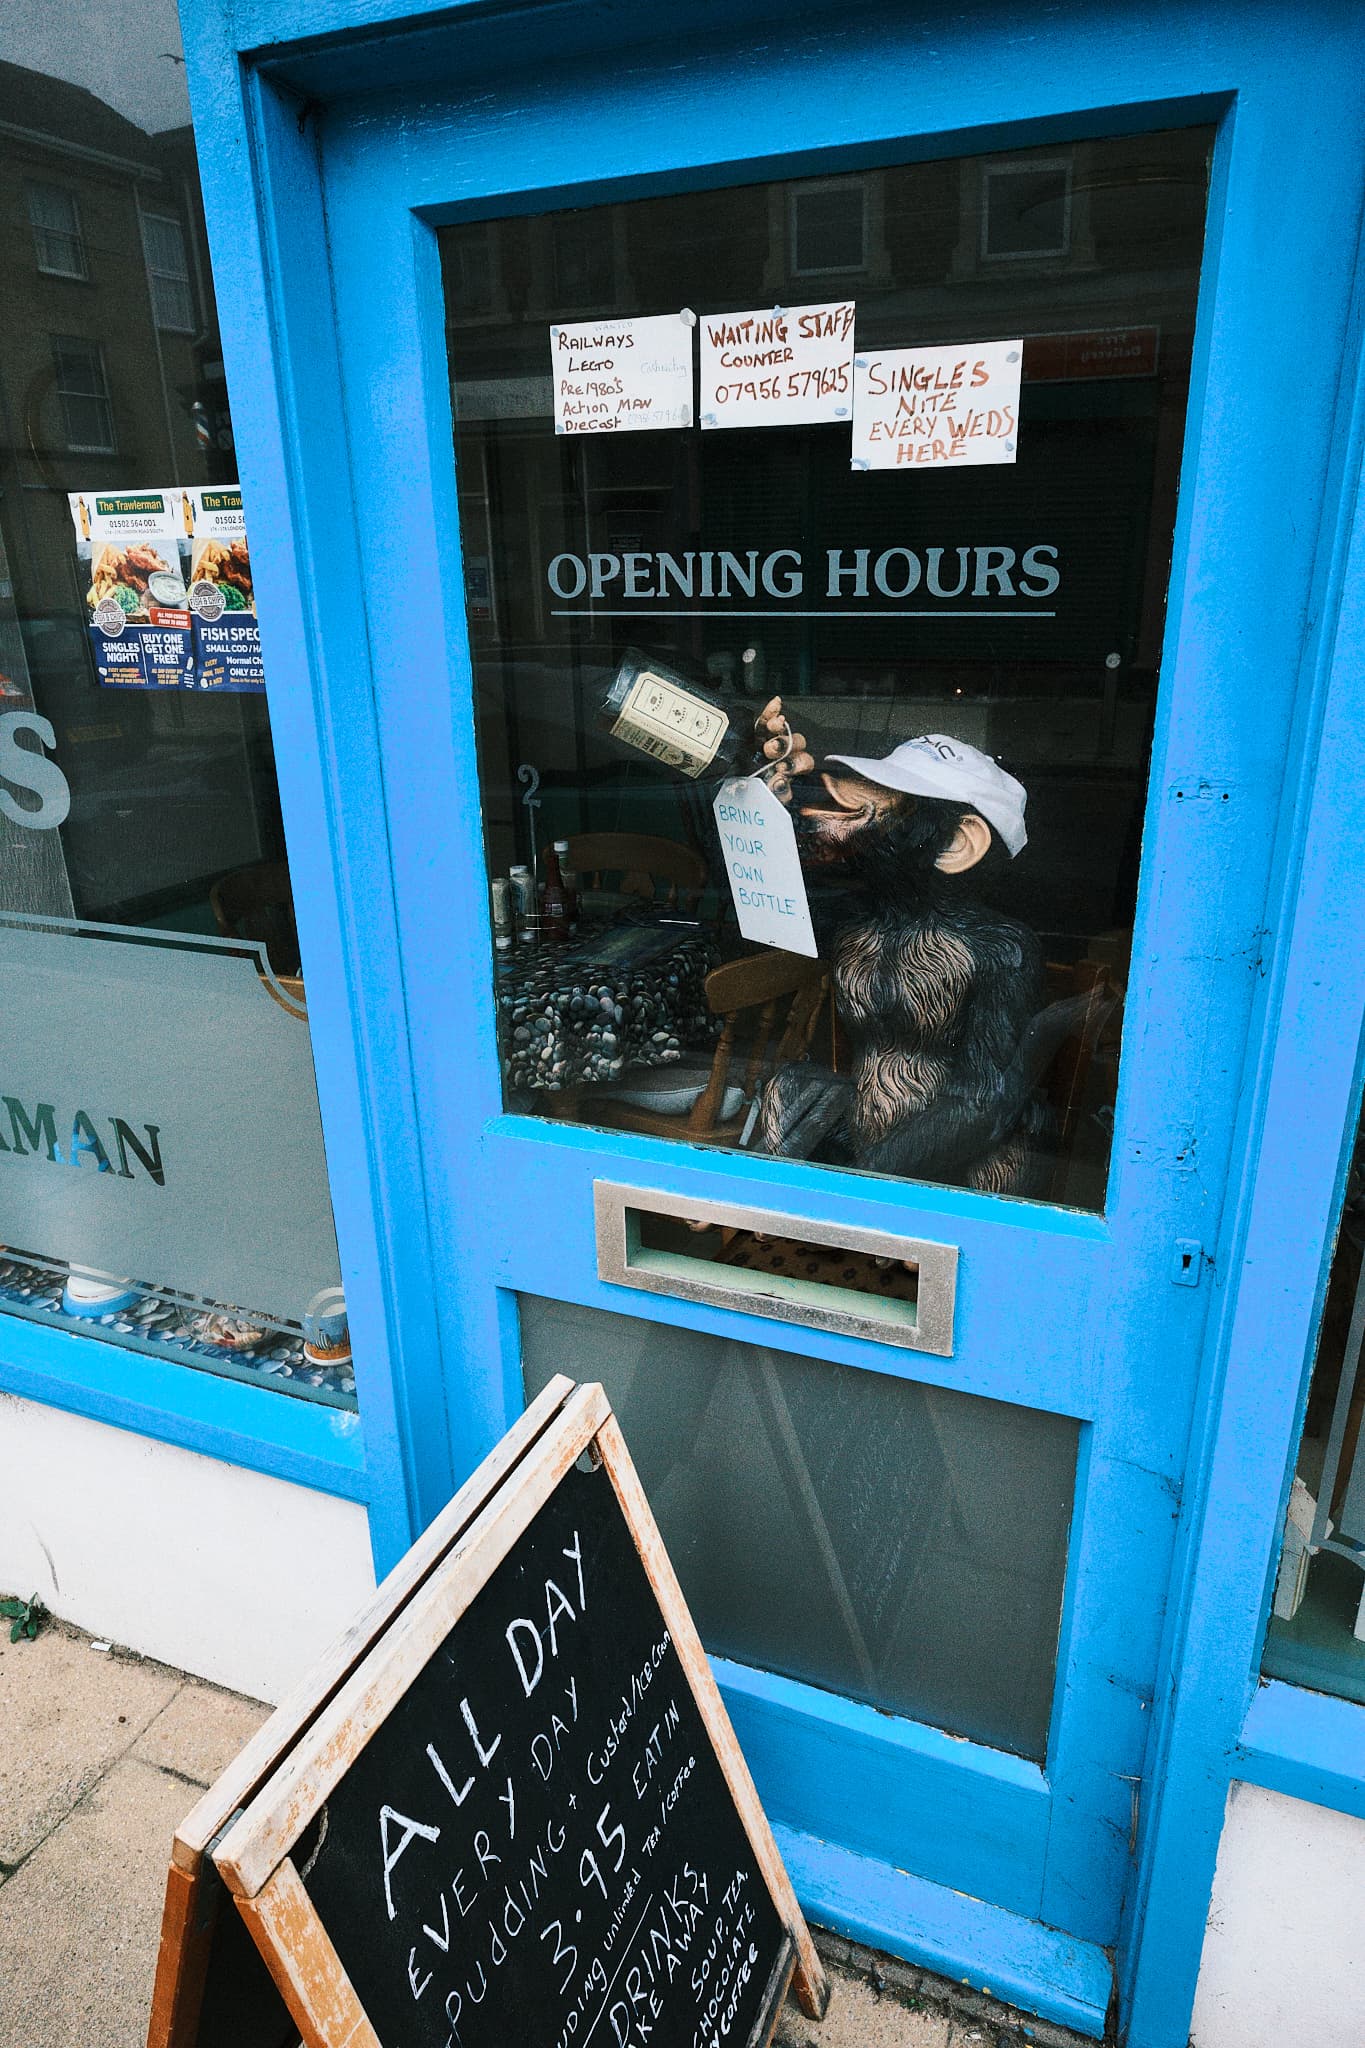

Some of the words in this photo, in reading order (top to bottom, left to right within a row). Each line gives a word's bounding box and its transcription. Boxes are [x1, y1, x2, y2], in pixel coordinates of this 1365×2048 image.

[558, 331, 634, 350] RAILWAYS
[708, 316, 788, 348] WAITING
[720, 347, 793, 368] COUNTER
[715, 375, 781, 404] 07956
[787, 361, 850, 399] 579625
[868, 360, 989, 396] SINGLES
[617, 398, 652, 413] MAN
[869, 415, 938, 441] EVERY
[947, 405, 1014, 439] WEDS
[896, 439, 967, 465] HERE
[99, 501, 114, 511] The
[115, 500, 162, 511] Trawlerman
[203, 496, 221, 507] The
[547, 549, 803, 599] OPENING
[826, 545, 1061, 598] HOURS
[142, 633, 163, 643] BUY
[163, 633, 183, 643] ONE
[200, 627, 229, 641] FISH
[102, 642, 140, 653] SINGLES
[106, 652, 139, 663] NIGHT!
[144, 644, 164, 654] GET
[164, 644, 185, 655] ONE
[205, 644, 231, 653] SMALL
[231, 644, 248, 653] COD
[153, 654, 179, 664] FREE!
[226, 656, 252, 665] Normal
[229, 668, 249, 677] ONLY
[517, 764, 541, 808] 2
[718, 804, 765, 826] BRING
[724, 834, 766, 856] YOUR
[732, 861, 764, 883] OWN
[738, 887, 795, 916] BOTTLE
[379, 1697, 502, 1921] ALL
[506, 1530, 586, 1698] DAY
[407, 1777, 514, 2000] EVERY
[530, 1676, 579, 1781] DAY
[642, 1825, 661, 1856] TEA
[539, 1802, 626, 1995] 3.95
[632, 1723, 663, 1800] EAT
[666, 1872, 709, 1984] AWAY
[609, 1862, 698, 2048] DRINKS
